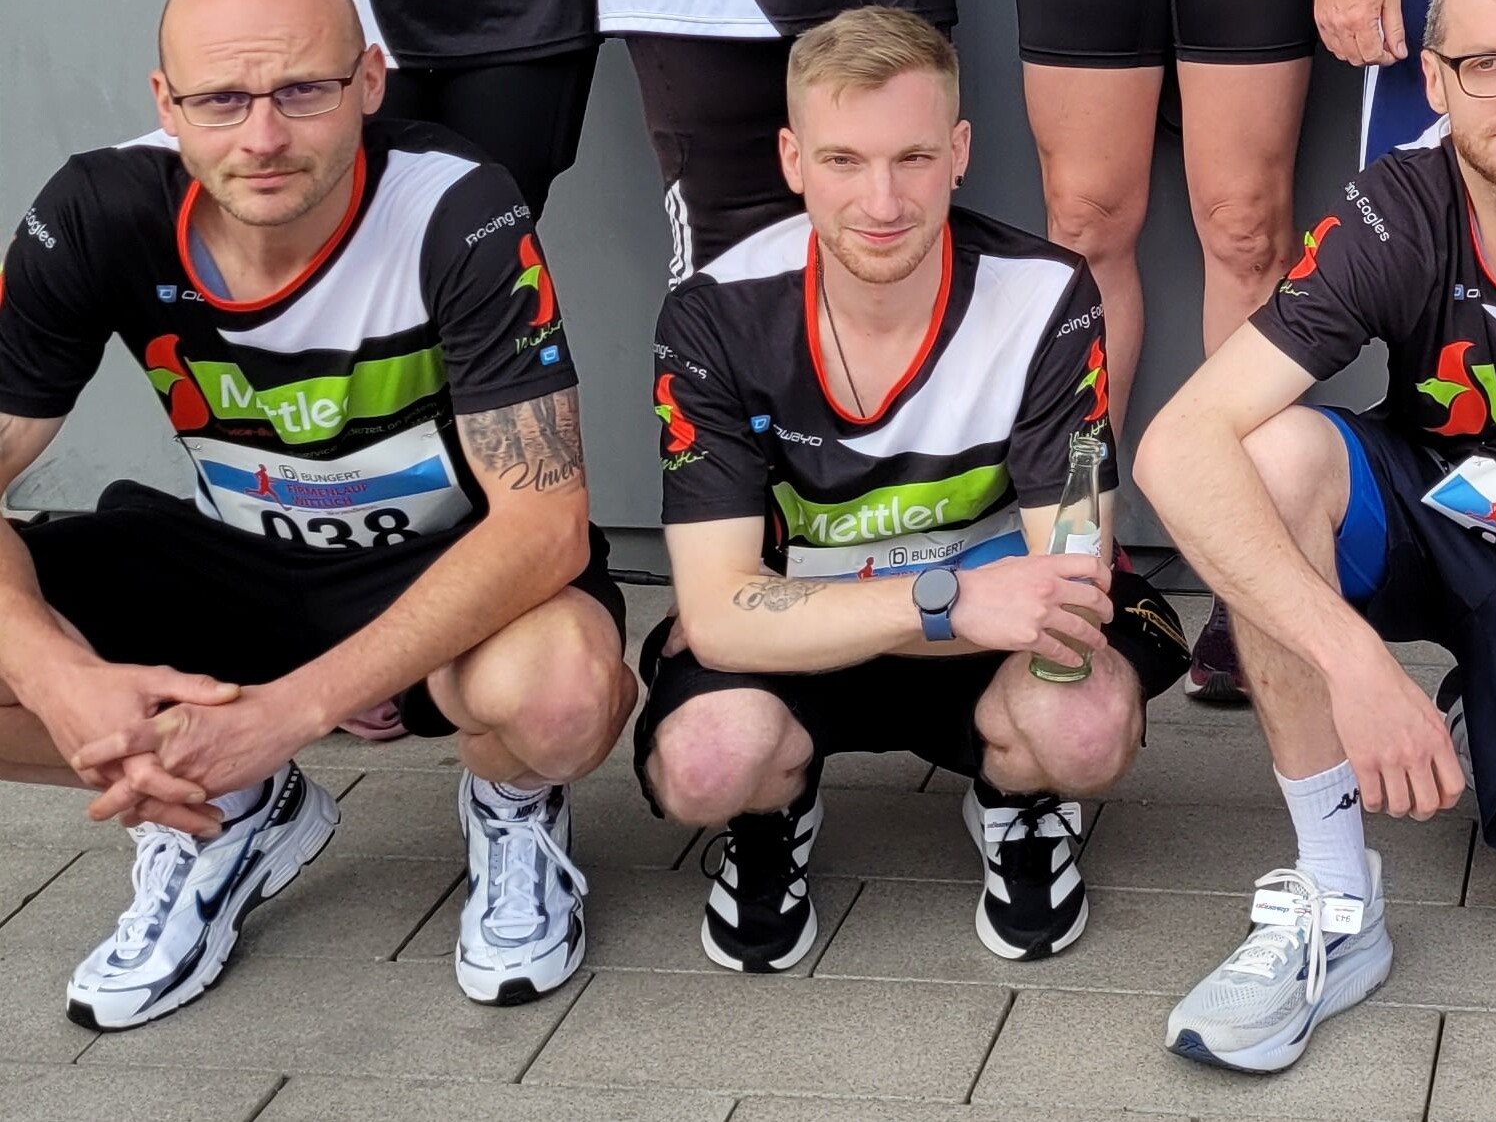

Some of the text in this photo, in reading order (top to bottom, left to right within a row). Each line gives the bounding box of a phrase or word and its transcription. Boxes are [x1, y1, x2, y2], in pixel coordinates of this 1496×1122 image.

[465, 208, 515, 247] Racing
[1356, 196, 1390, 242] Eagles
[301, 470, 361, 482] BUNGERT
[286, 484, 368, 498] FIRMENLAUF
[292, 496, 352, 507] WITTLICH
[911, 540, 965, 562] BUNGERT
